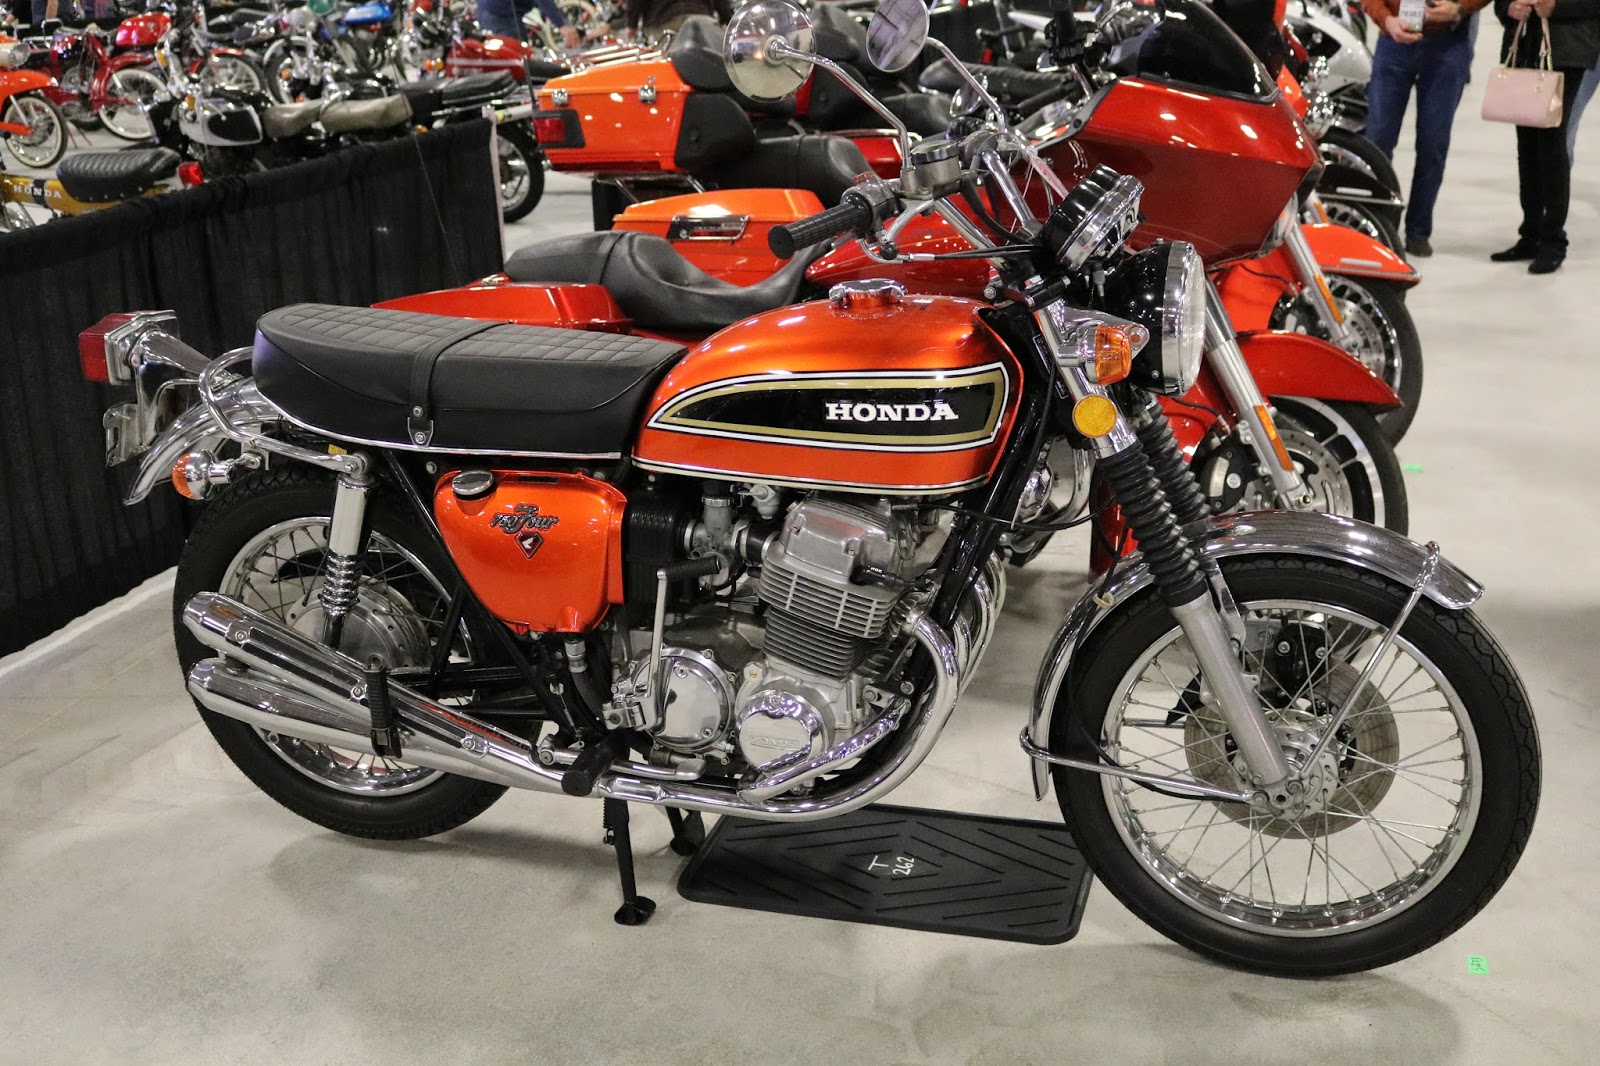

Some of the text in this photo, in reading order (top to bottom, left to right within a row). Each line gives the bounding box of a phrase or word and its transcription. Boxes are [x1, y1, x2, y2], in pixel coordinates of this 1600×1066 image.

[13, 185, 62, 199] HONDA
[825, 402, 959, 422] HONDA
[868, 855, 889, 870] T
[892, 856, 915, 876] 262
